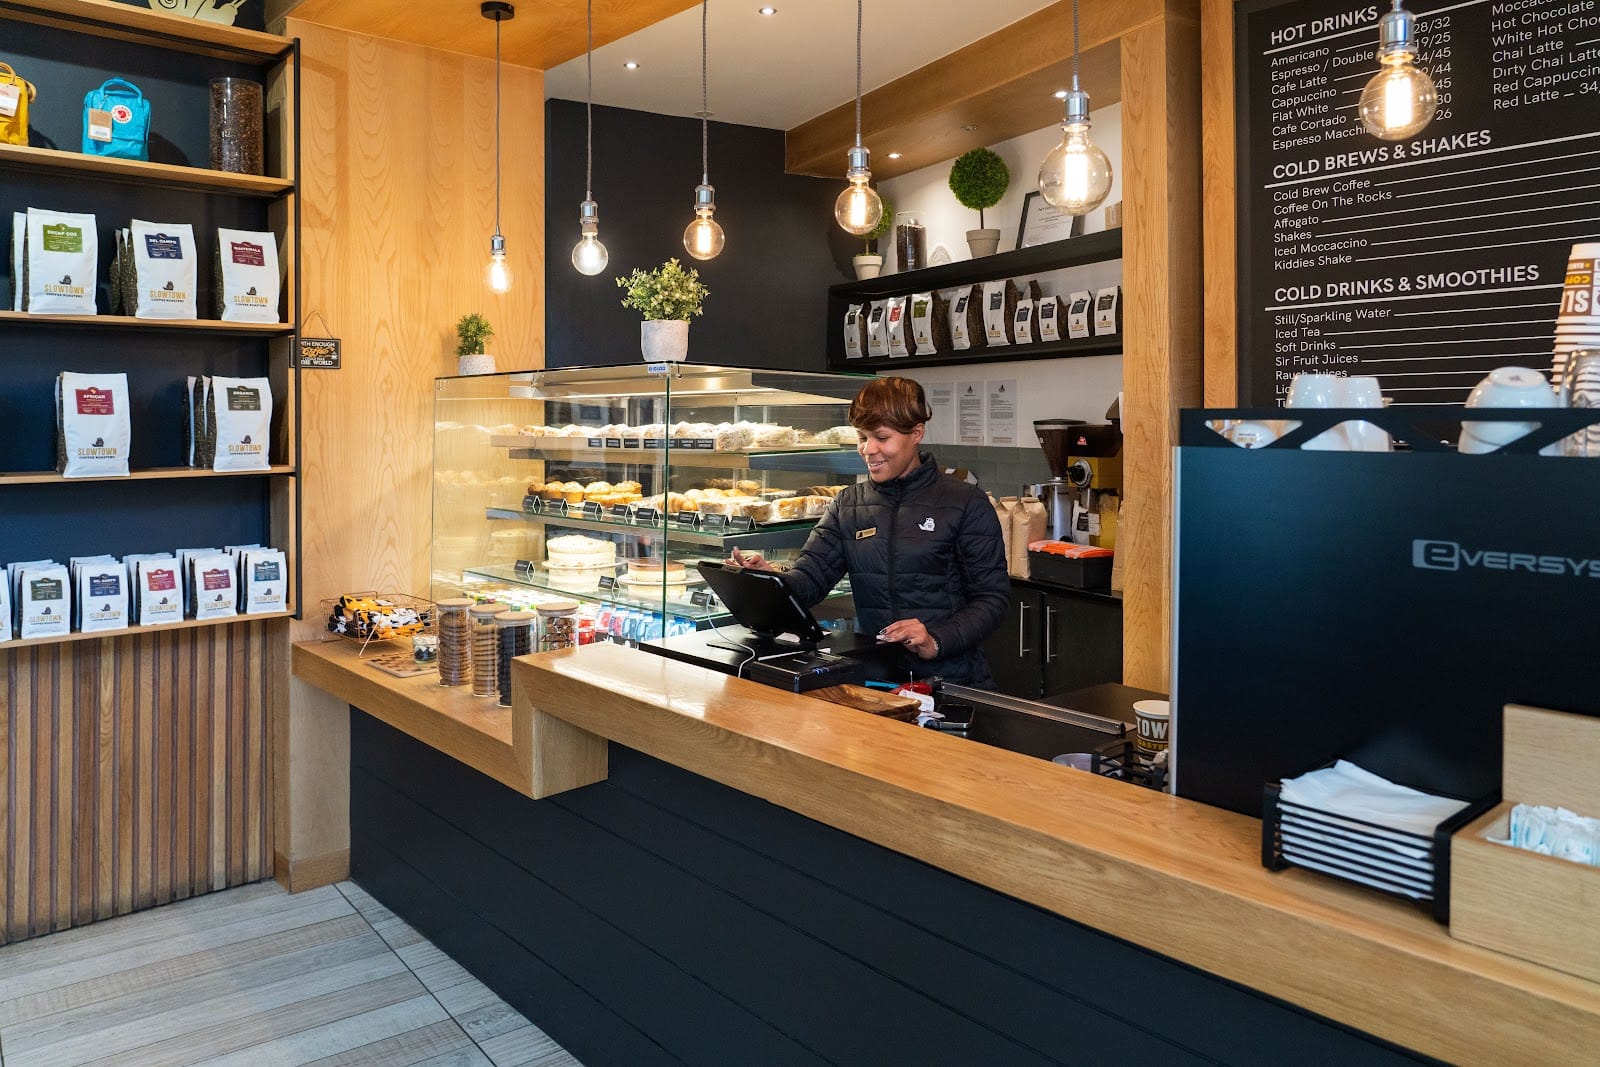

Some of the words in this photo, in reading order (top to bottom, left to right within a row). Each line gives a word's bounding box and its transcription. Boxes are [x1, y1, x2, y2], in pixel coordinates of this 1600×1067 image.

[1271, 24, 1306, 45] HOT
[1311, 6, 1378, 35] DRINKS
[1491, 17, 1516, 32] Hot
[1521, 0, 1594, 24] Chocolate
[1492, 31, 1532, 47] White
[1538, 23, 1563, 37] Hot
[1568, 16, 1600, 30] Cho
[1271, 47, 1330, 68] Americano
[1493, 46, 1523, 62] Chai
[1529, 40, 1564, 55] Latte
[1271, 63, 1320, 82] Espresso
[1332, 50, 1374, 68] Double
[1493, 64, 1527, 78] Dirty
[1531, 54, 1563, 70] Chai
[1271, 82, 1296, 95] Cafe
[1300, 75, 1328, 89] Latte
[1493, 80, 1518, 94] Red
[1523, 64, 1600, 88] Cappuccin
[1271, 88, 1337, 110] Cappuccino
[1494, 95, 1519, 110] Red
[1524, 90, 1559, 105] Latte
[1272, 110, 1292, 123] Flat
[1296, 102, 1329, 117] White
[1436, 108, 1452, 121] 26
[1272, 123, 1297, 137] Cafe
[1300, 114, 1347, 131] Cortado
[1273, 133, 1321, 151] Espresso
[1325, 124, 1370, 140] Macchi
[1273, 160, 1320, 179] COLD
[1325, 146, 1389, 171] BREWS
[1393, 144, 1406, 159] &
[1410, 130, 1491, 157] SHAKES
[1274, 190, 1298, 202] Cold
[1303, 185, 1330, 198] Brew
[1332, 179, 1371, 193] Coffee
[1274, 203, 1309, 216] Coffee
[1312, 200, 1328, 211] On
[1331, 195, 1353, 208] The
[1357, 189, 1392, 204] Rocks
[1274, 215, 1319, 230] Affogato
[1274, 230, 1312, 243] Shakes
[1274, 244, 1297, 257] Iced
[1301, 238, 1367, 254] Moccaccino
[1274, 257, 1315, 271] Kiddies
[1318, 253, 1352, 266] Shake
[44, 284, 84, 294] SLOWTOWN
[1274, 285, 1322, 301] COLD
[1327, 277, 1394, 298] DRINKS
[1398, 276, 1411, 291] &
[1416, 264, 1540, 290] SMOOTHIES
[150, 290, 186, 299] SLOWTOWN
[234, 295, 269, 304] SLOWTOWN
[1275, 310, 1352, 326] Still/Sparkling
[1355, 307, 1391, 319] Water
[1275, 328, 1297, 339] Iced
[1301, 327, 1320, 338] Tea
[1275, 341, 1297, 353] Soft
[1300, 340, 1336, 351] Drinks
[1275, 356, 1291, 367] Sir
[1293, 354, 1319, 365] Fruit
[1321, 353, 1359, 364] Juices
[77, 447, 117, 456] SLOWTOWN
[228, 443, 261, 452] SLOWTOWN
[1135, 716, 1168, 739] TOW
